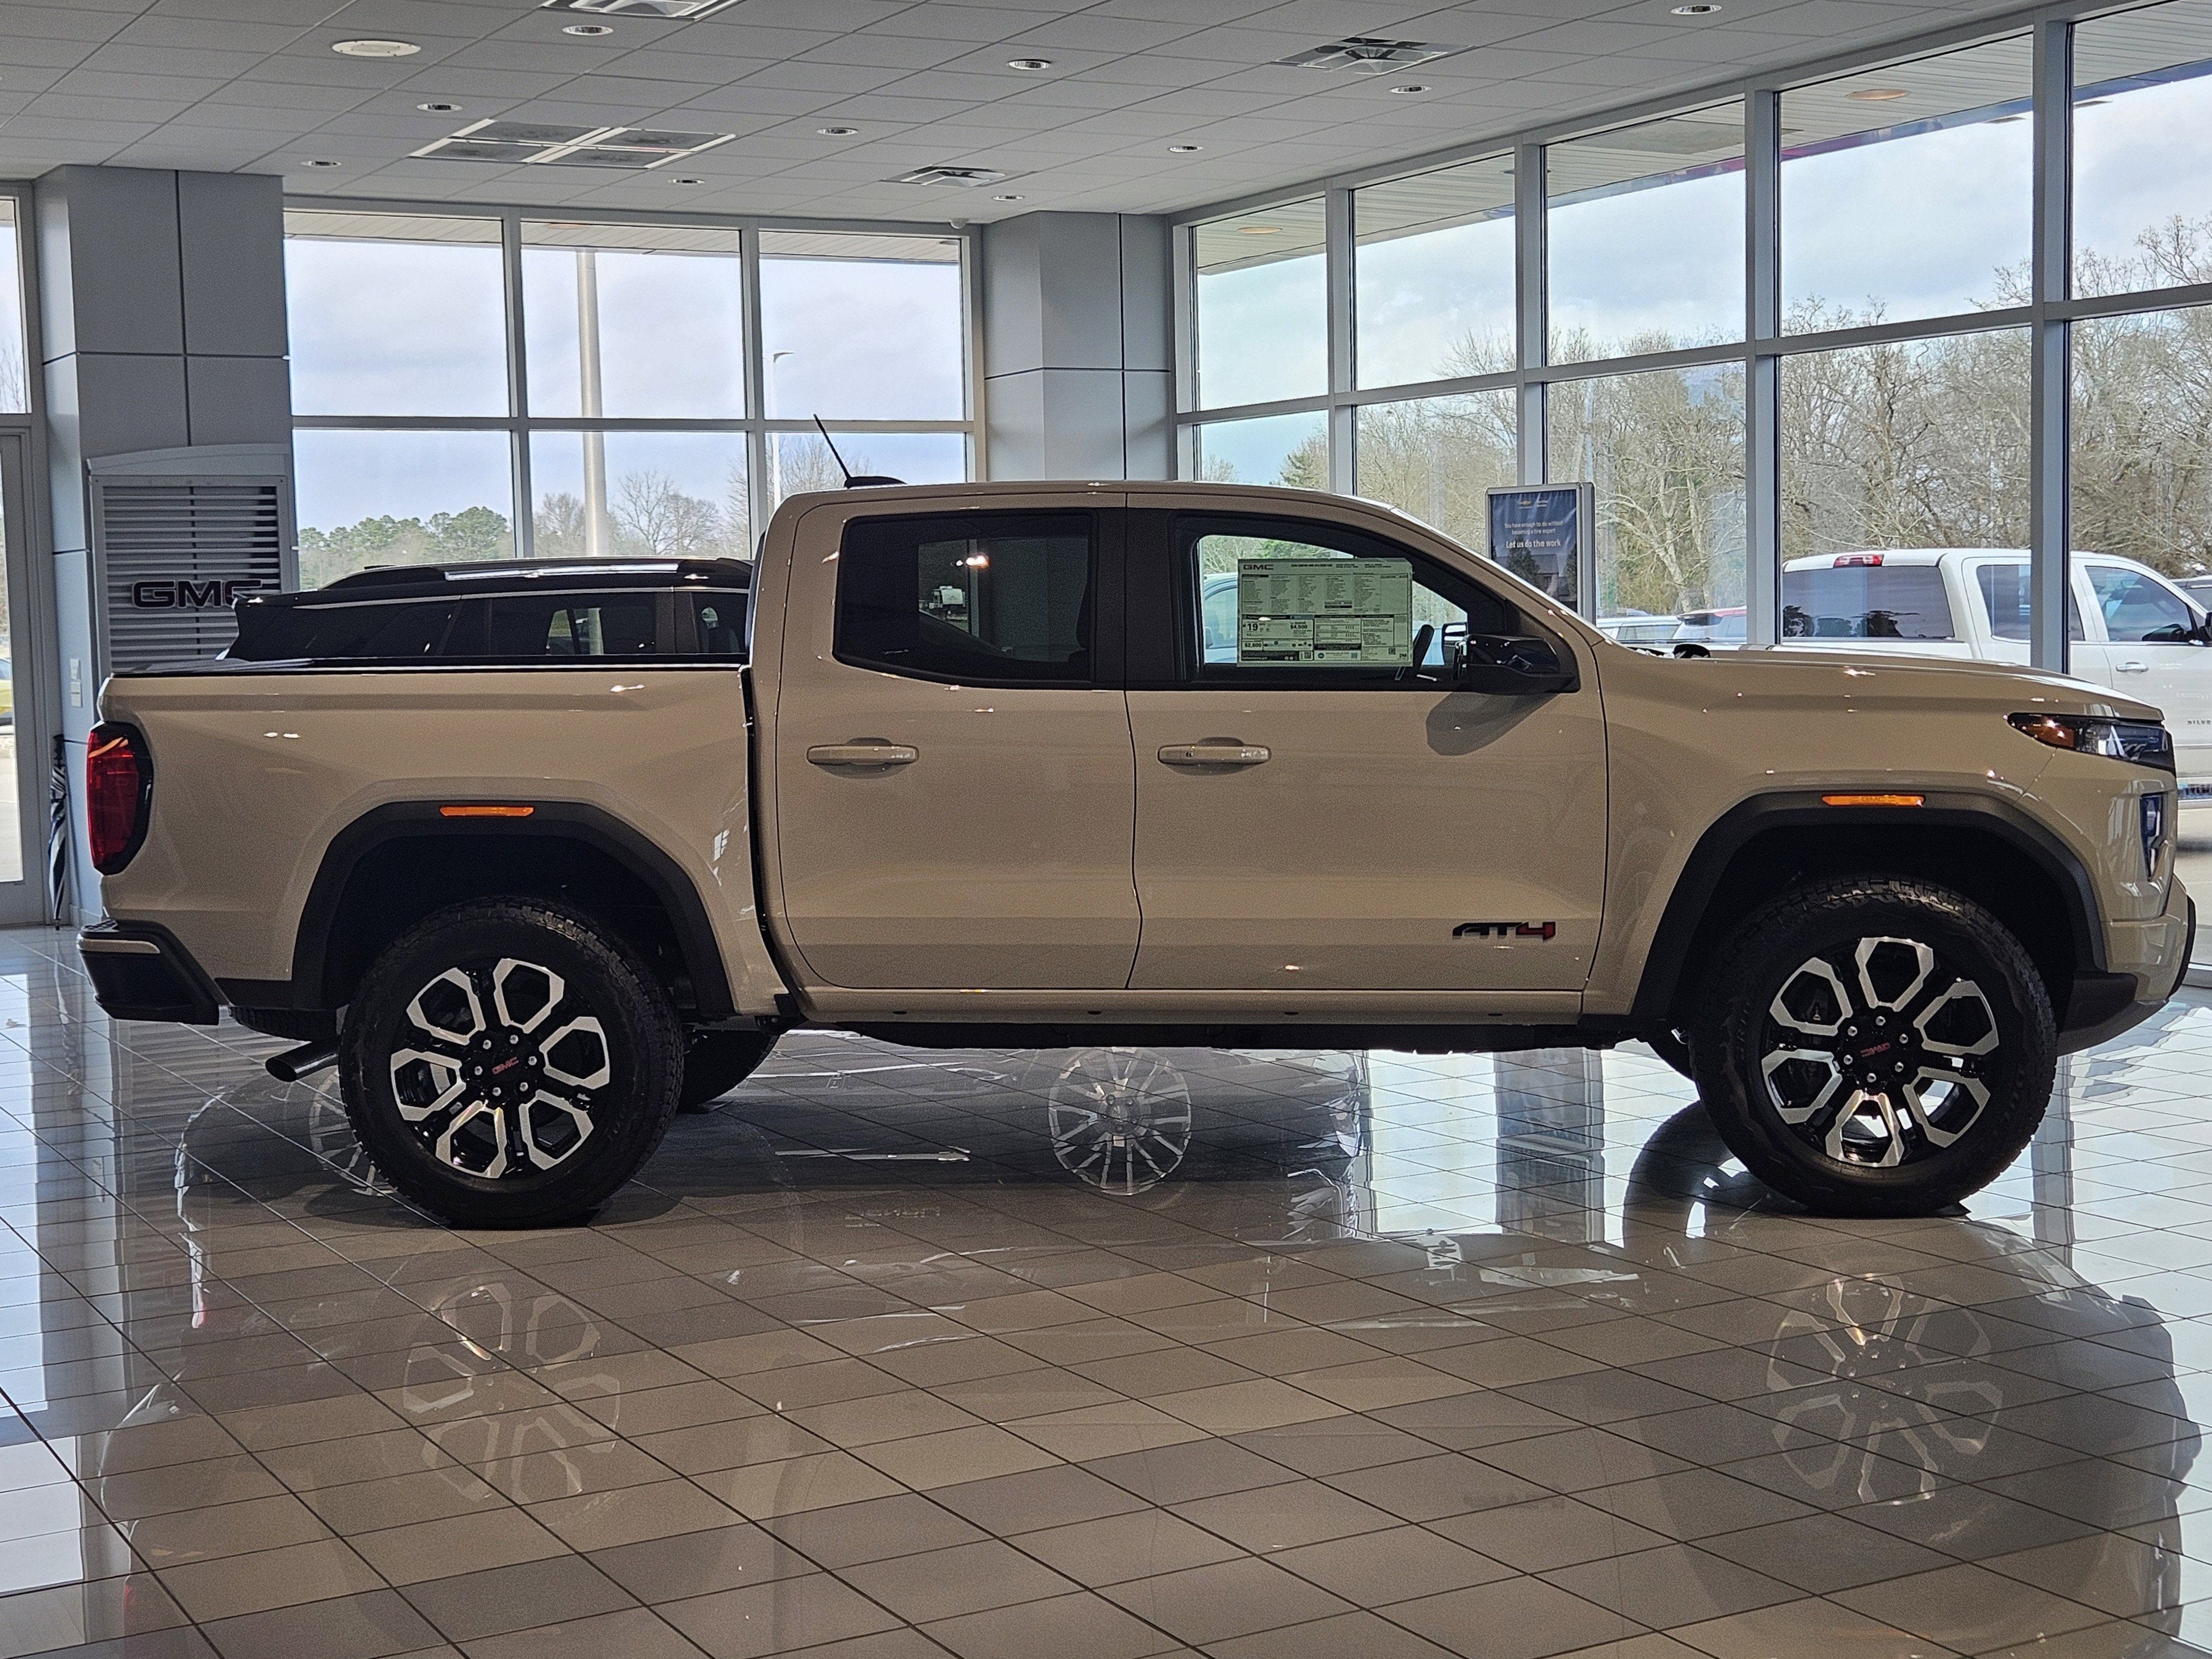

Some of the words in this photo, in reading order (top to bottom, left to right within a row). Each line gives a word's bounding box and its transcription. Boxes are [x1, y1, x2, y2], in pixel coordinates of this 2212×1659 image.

[1525, 539, 1532, 548] do
[1533, 539, 1545, 548] the
[1546, 538, 1561, 547] work
[1453, 921, 1556, 940] AT4
[492, 1056, 519, 1074] GMC
